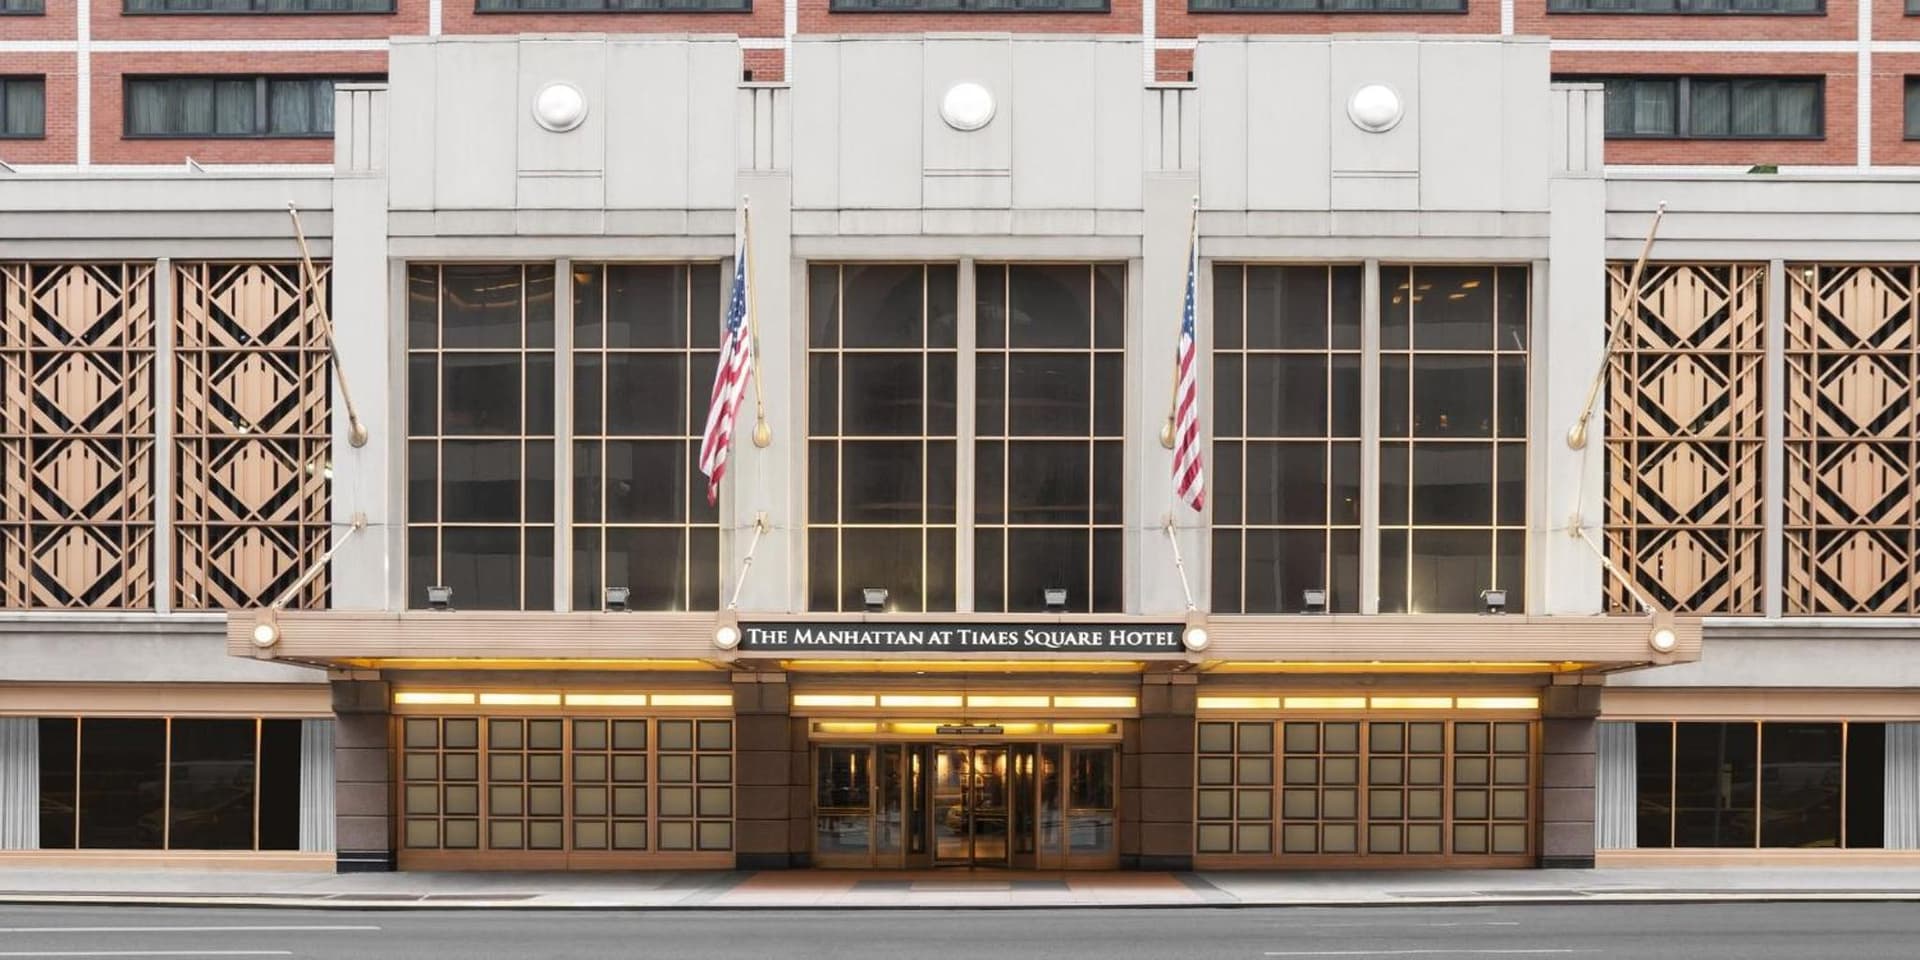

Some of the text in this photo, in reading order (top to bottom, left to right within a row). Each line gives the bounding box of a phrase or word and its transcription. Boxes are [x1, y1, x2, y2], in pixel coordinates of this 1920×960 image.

[746, 628, 1178, 649] THE MANHATTAN AT TIMES SQUARE HOTEL
